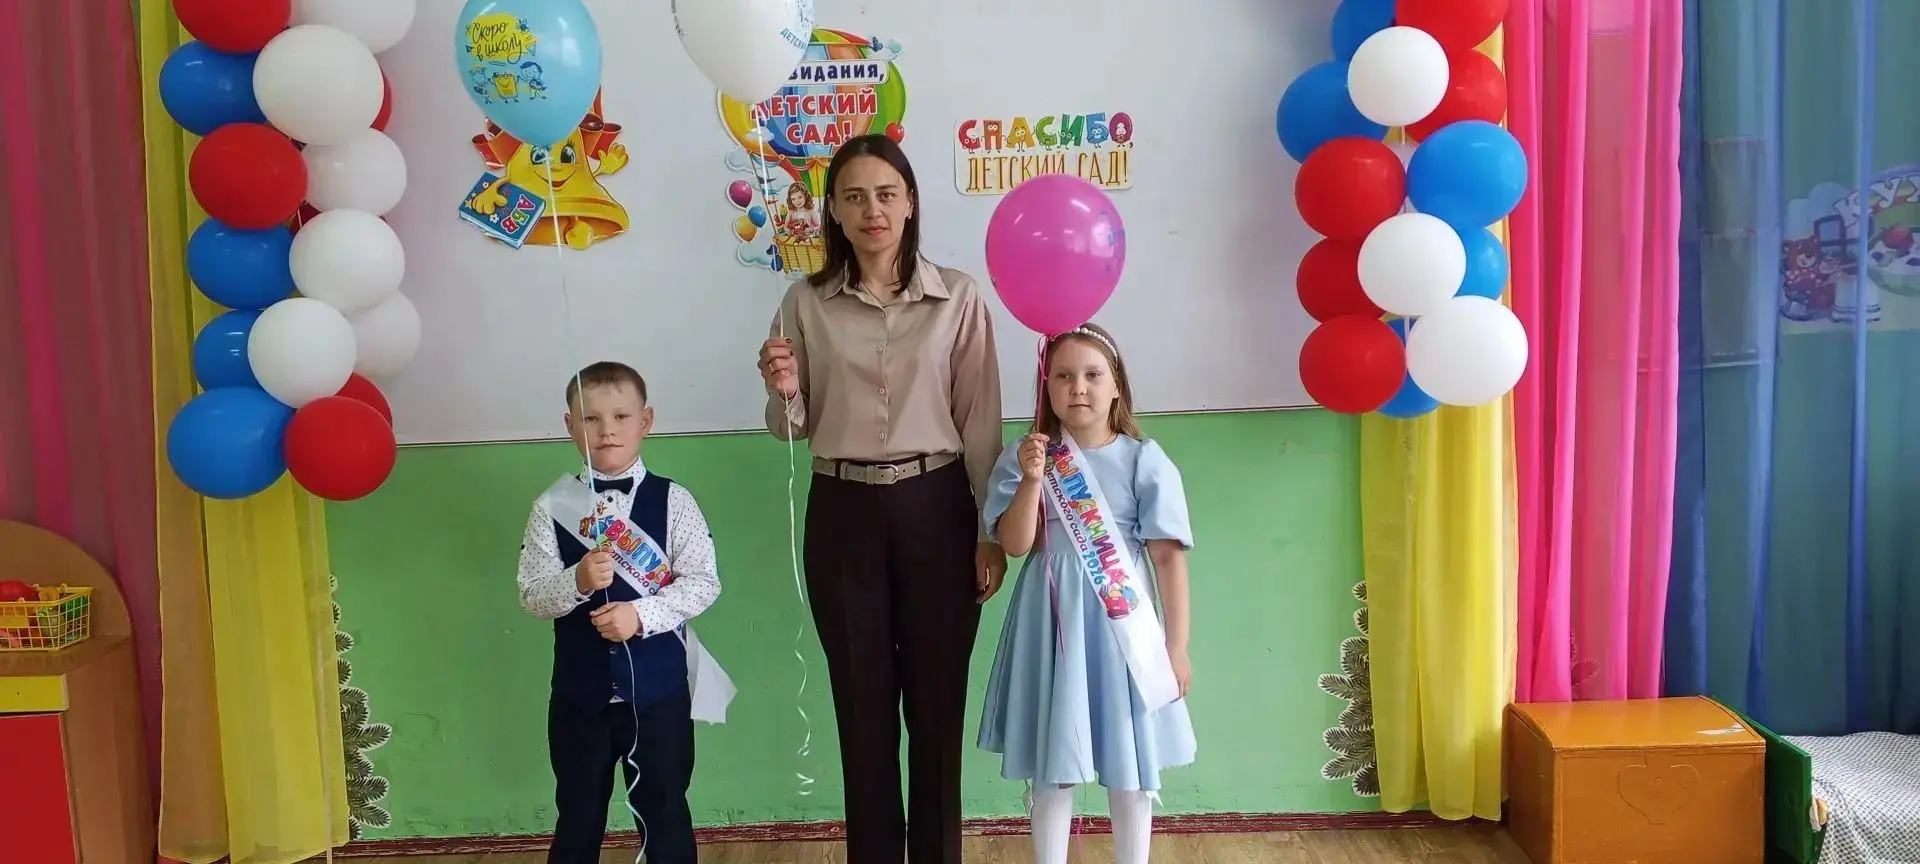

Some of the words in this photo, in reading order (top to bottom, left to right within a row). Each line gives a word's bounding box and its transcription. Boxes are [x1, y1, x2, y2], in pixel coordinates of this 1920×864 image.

[472, 22, 509, 44] Скоро
[485, 33, 526, 64] школу
[751, 88, 877, 120] ДЕТСКИЙ
[786, 121, 852, 145] САД!
[958, 111, 1134, 153] СПАСИБО,
[966, 151, 1066, 193] ДЕТСКИЙ
[1078, 150, 1129, 187] САД!
[501, 194, 536, 234] АБВ
[1045, 464, 1074, 521] детского
[1070, 521, 1088, 553] сада
[1082, 549, 1108, 586] 2026
